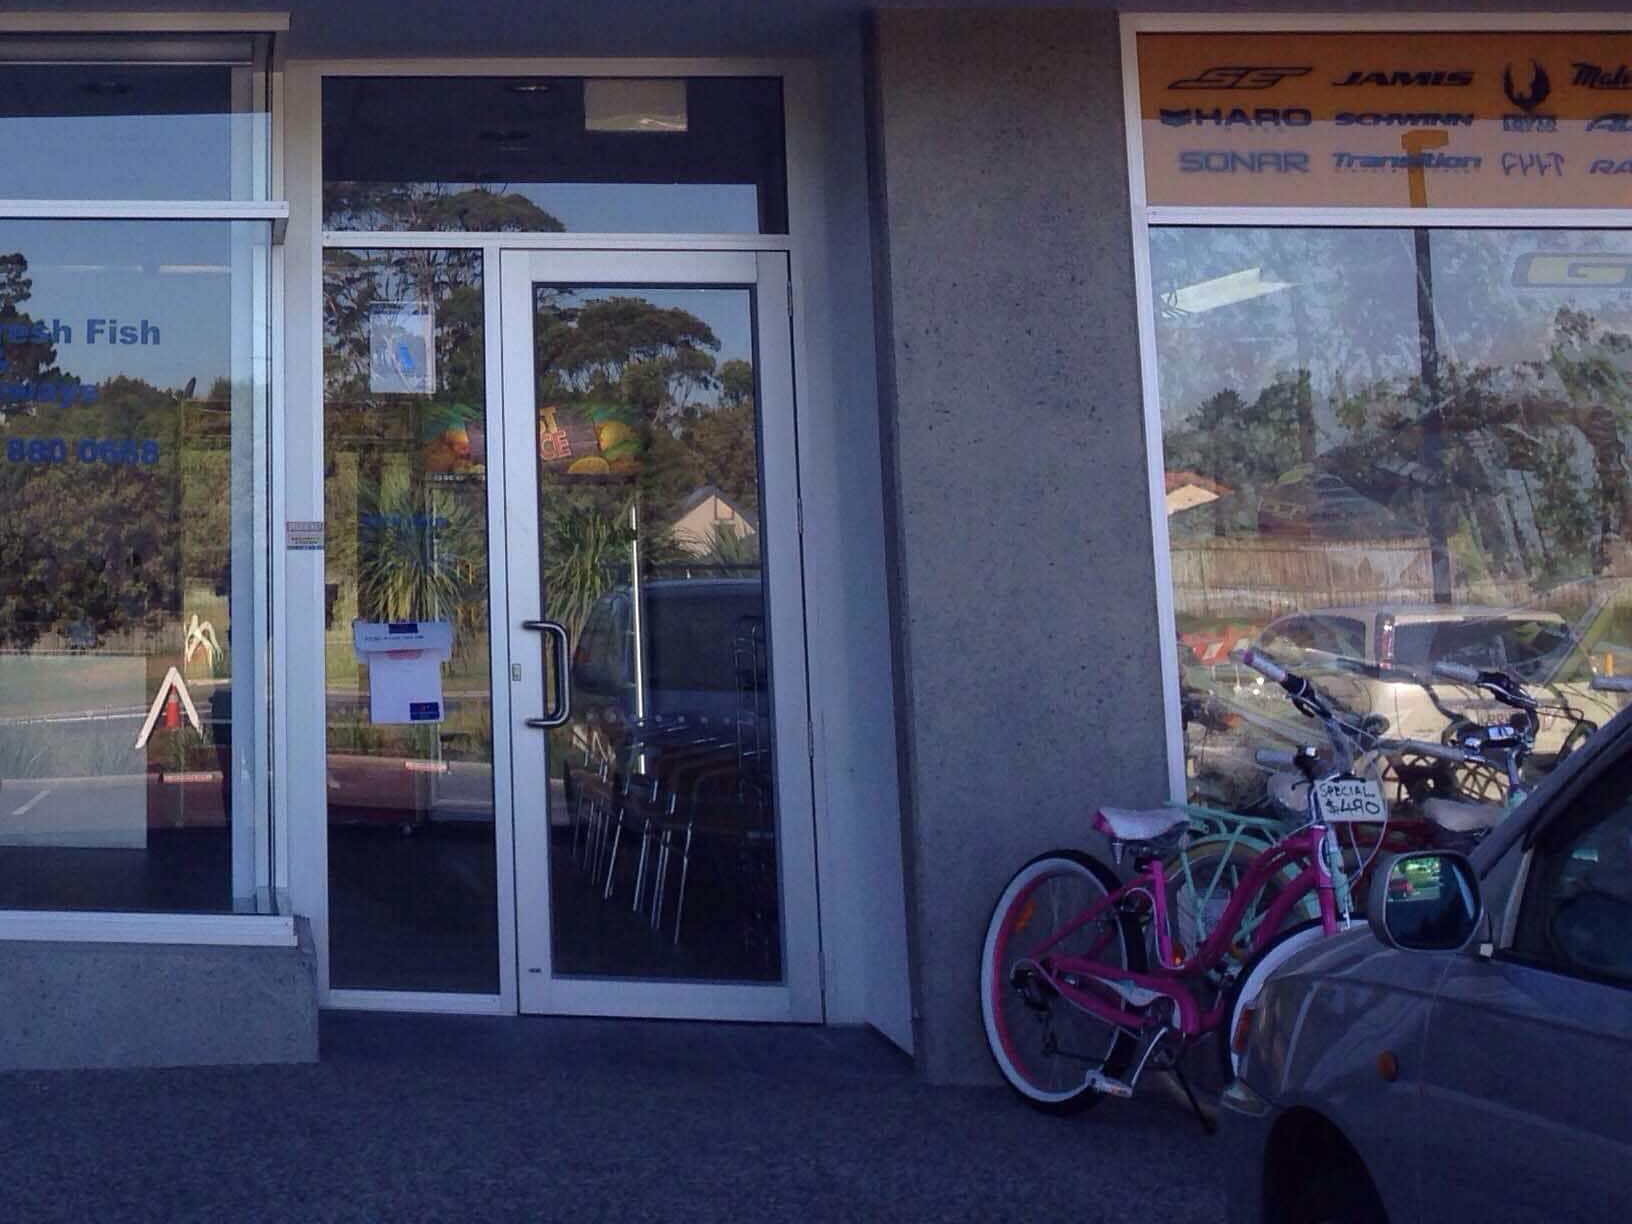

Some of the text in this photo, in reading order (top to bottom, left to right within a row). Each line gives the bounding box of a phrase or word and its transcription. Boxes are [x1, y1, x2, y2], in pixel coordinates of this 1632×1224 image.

[1332, 71, 1475, 87] JAMIS
[1194, 107, 1313, 127] HARO
[1334, 112, 1475, 127] SCHWINN
[1178, 150, 1311, 174] SONAR
[86, 318, 161, 345] Fish
[1319, 782, 1376, 798] SPECIAL
